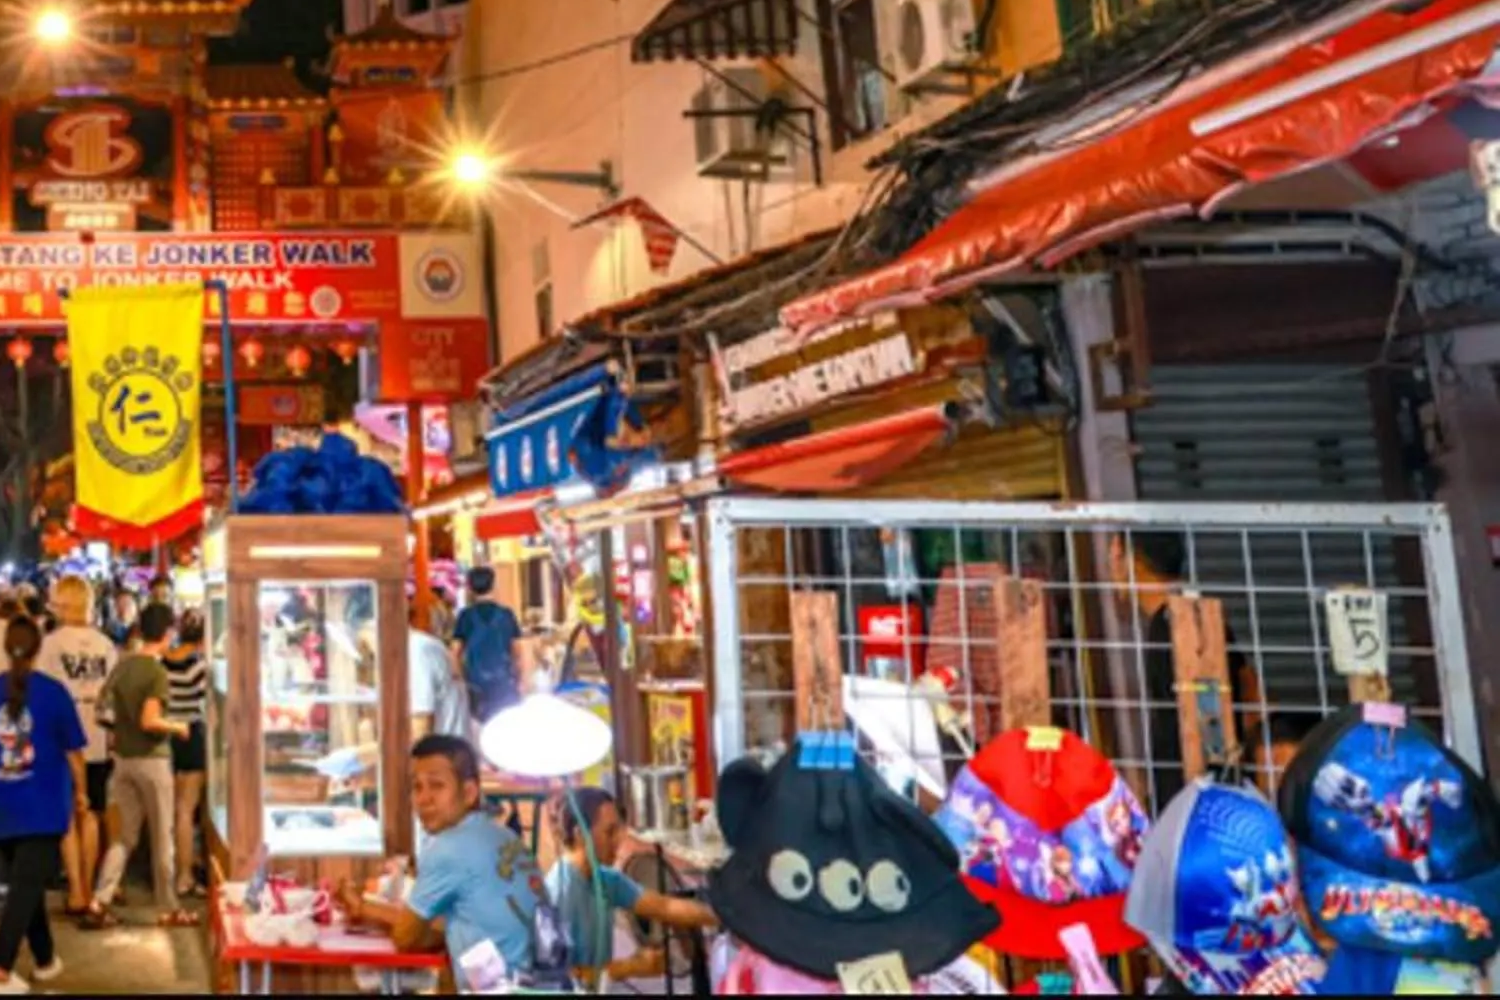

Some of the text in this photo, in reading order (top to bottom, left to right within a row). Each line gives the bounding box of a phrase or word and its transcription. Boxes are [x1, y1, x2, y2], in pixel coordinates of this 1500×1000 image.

[93, 243, 134, 264] KE
[147, 243, 269, 264] JONKER
[283, 242, 372, 263] WALK
[1348, 617, 1380, 660] 5
